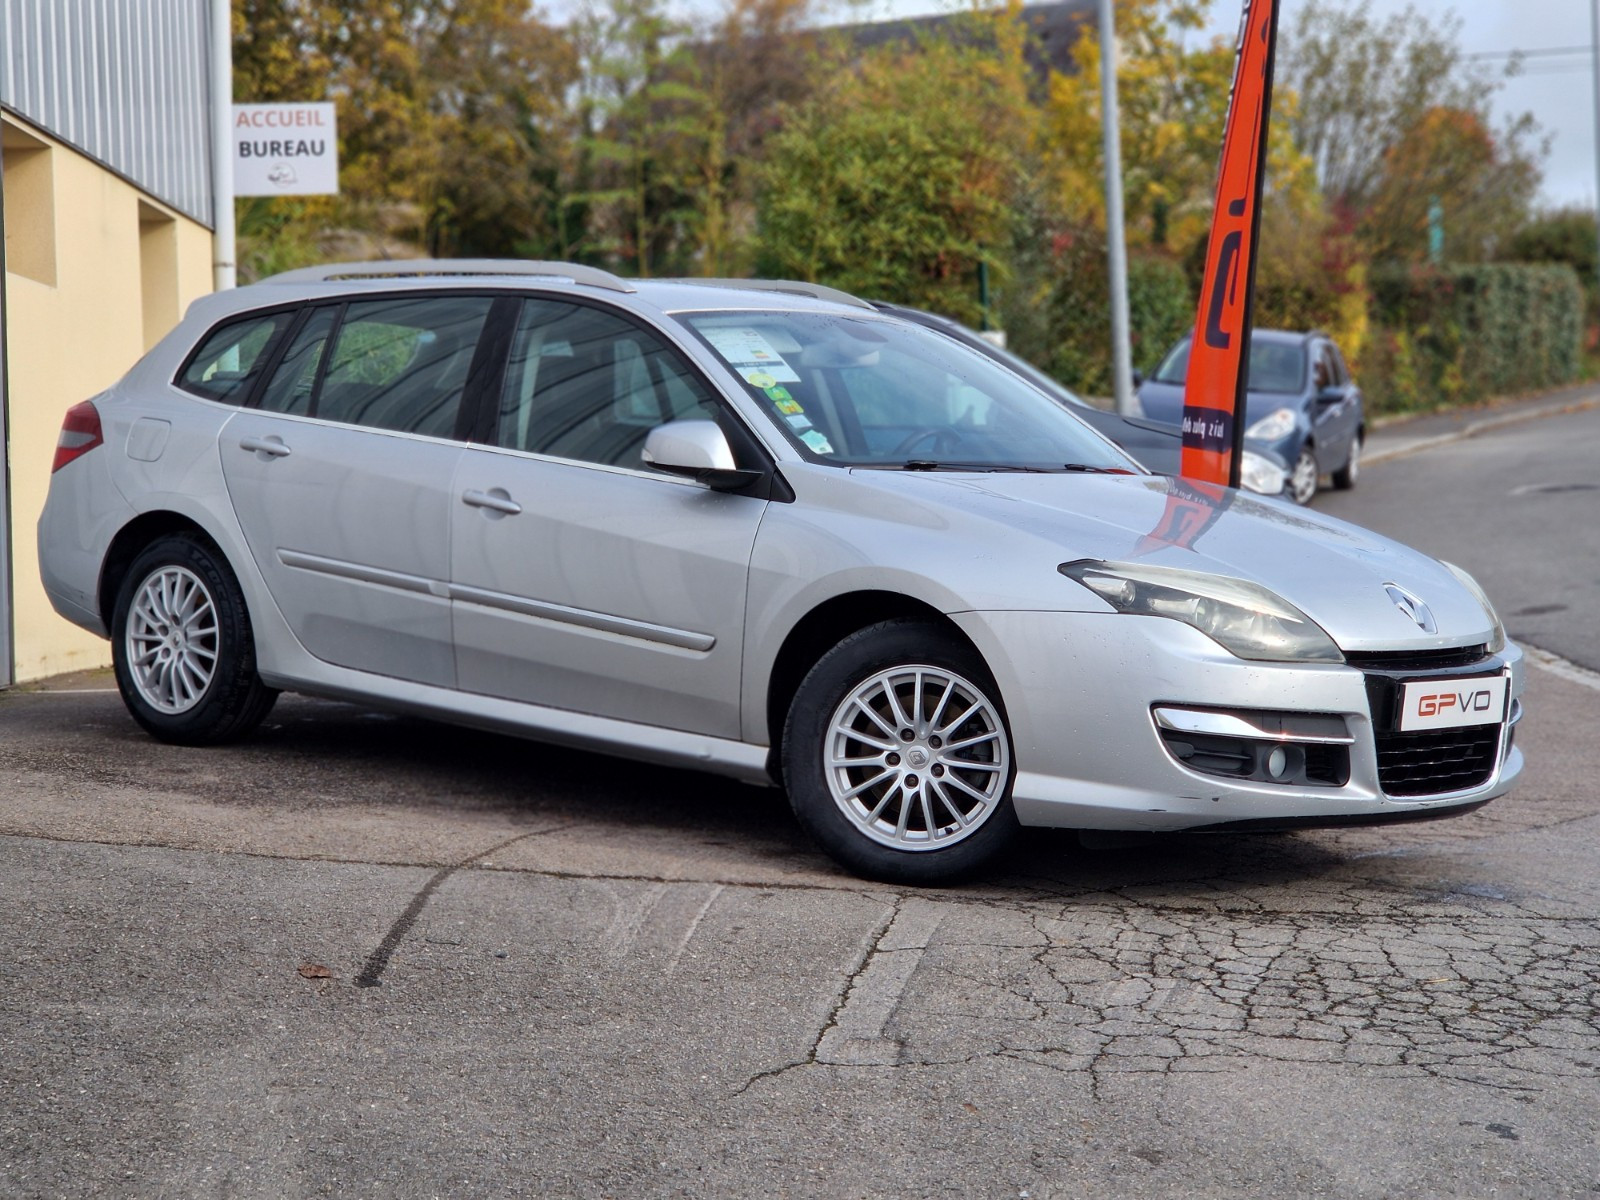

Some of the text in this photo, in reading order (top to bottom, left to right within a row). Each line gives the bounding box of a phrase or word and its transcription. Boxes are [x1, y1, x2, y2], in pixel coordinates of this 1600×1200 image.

[236, 110, 325, 128] ACCUEIL
[239, 140, 326, 158] BUREAU
[1418, 690, 1491, 717] GPVO
